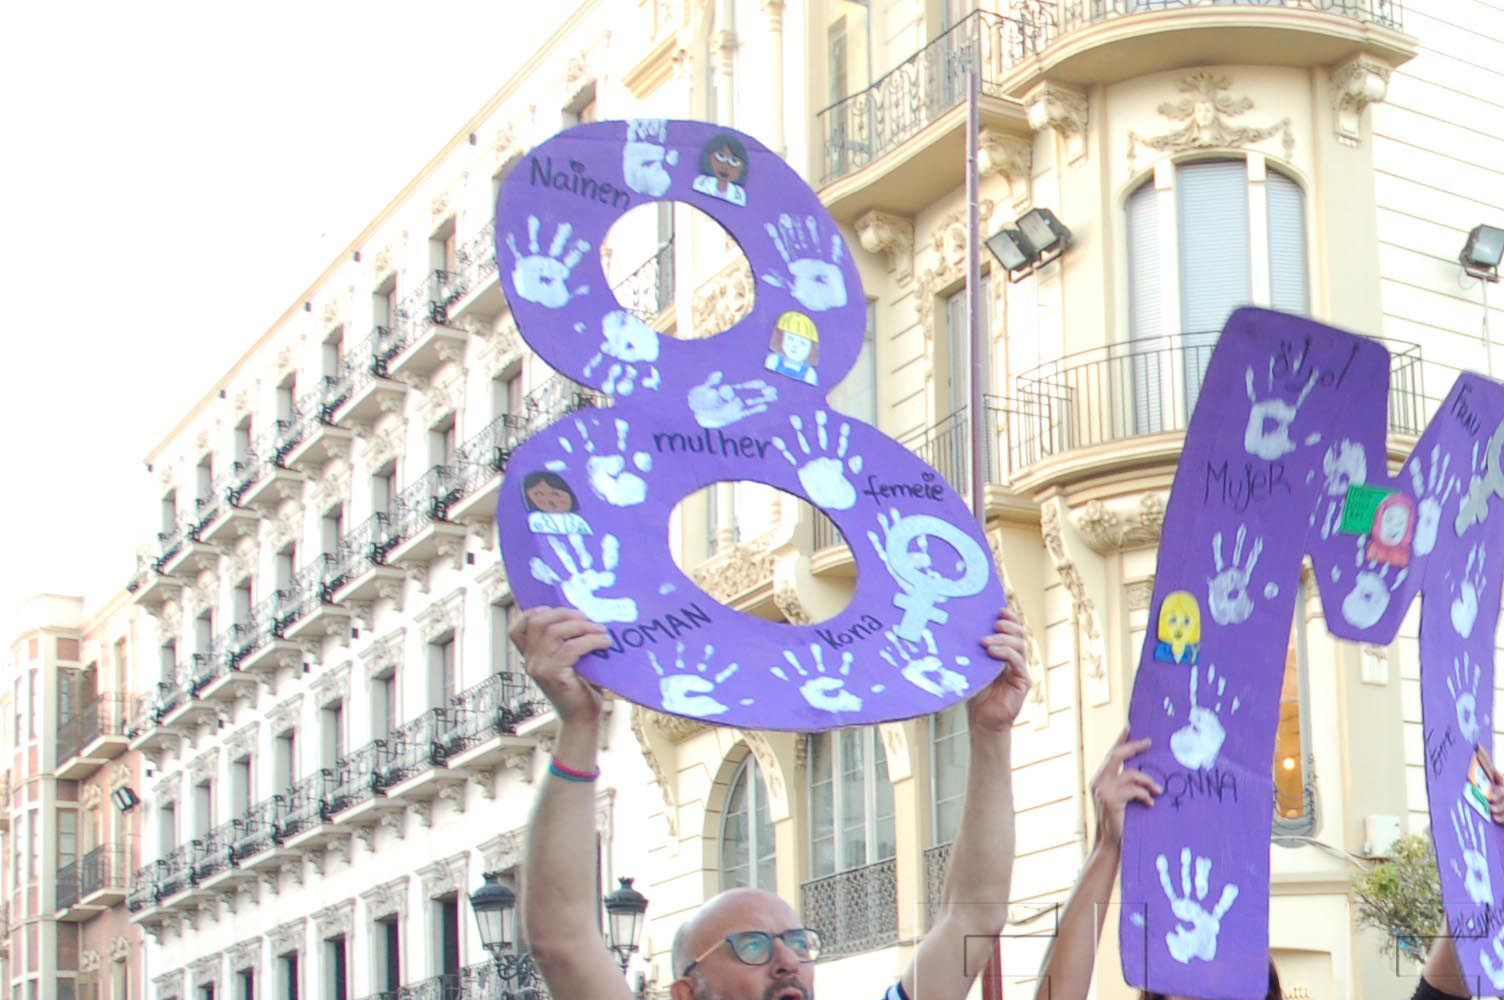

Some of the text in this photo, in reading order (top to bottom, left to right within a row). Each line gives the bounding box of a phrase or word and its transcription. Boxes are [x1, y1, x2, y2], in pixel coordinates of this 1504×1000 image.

[652, 428, 777, 461] mulher
[862, 471, 944, 504] femeie
[595, 603, 713, 661] WOMAN
[1139, 763, 1237, 807] DONNA
